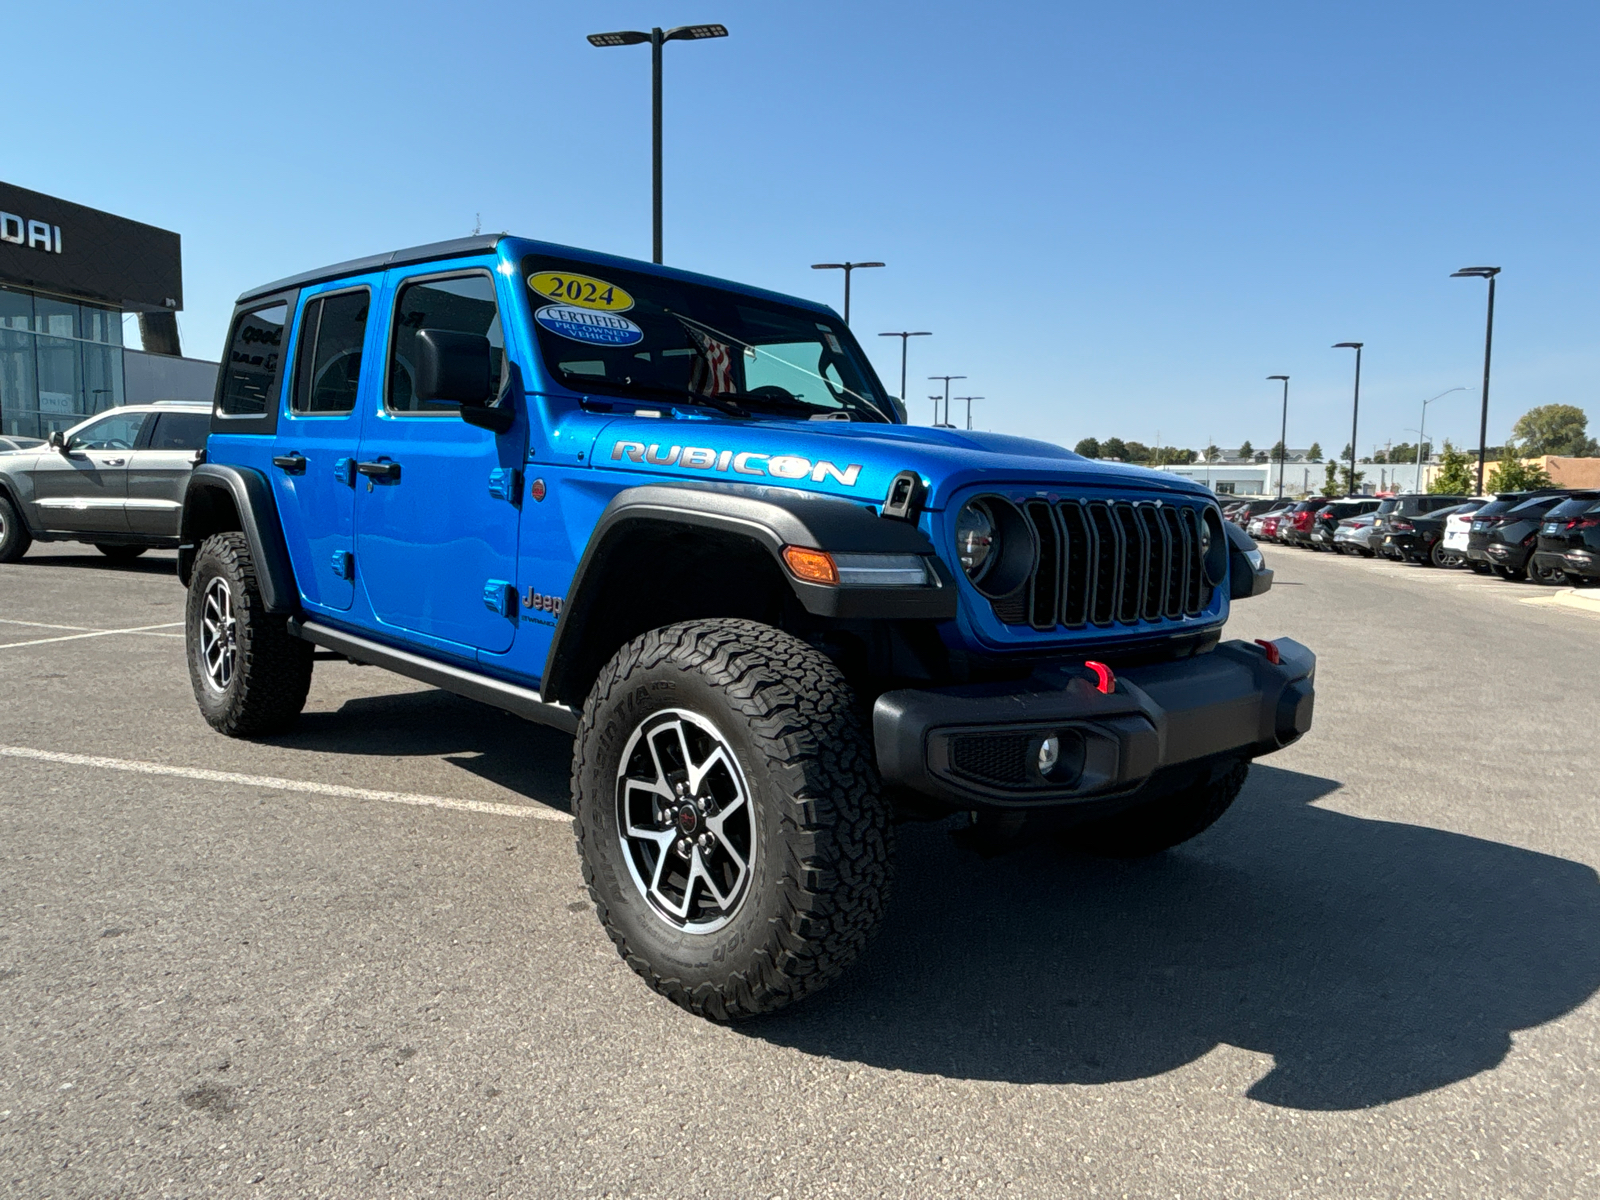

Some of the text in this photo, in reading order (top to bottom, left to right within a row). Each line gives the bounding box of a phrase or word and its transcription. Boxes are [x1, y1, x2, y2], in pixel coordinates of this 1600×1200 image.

[0, 212, 61, 254] DAI
[549, 278, 614, 305] 2024
[546, 308, 630, 330] CERTIFIED
[554, 321, 629, 338] PRE-OWNED
[568, 330, 622, 343] VEHICLE
[611, 441, 863, 486] RUBICON
[522, 586, 563, 617] Jeep
